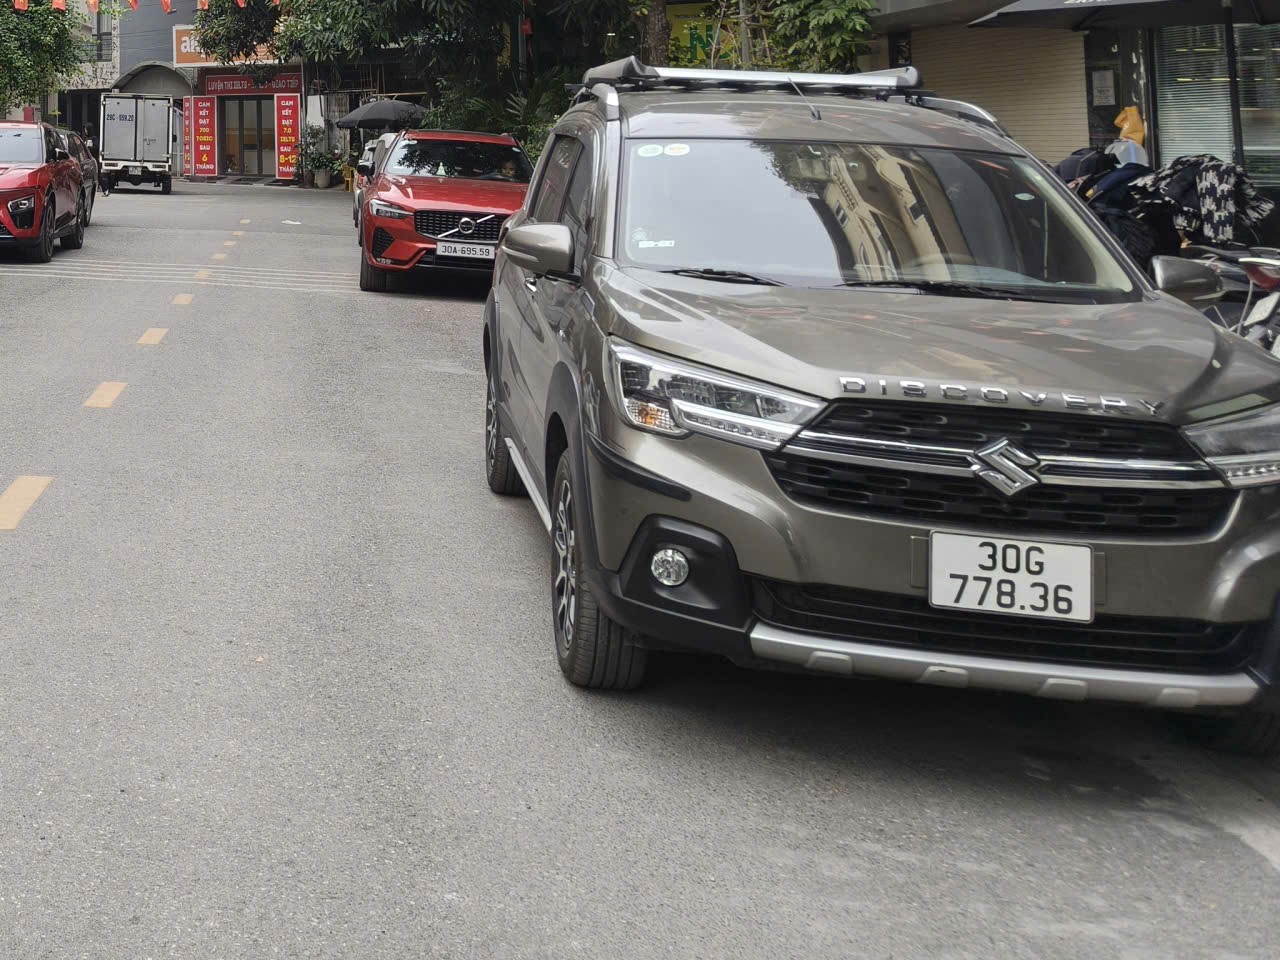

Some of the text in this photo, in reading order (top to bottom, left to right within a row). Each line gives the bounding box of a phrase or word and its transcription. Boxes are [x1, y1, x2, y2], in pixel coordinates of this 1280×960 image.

[202, 153, 208, 162] 6
[441, 245, 490, 257] 30A-695.59
[838, 375, 1166, 417] DISCOVERY
[978, 541, 1045, 576] 30G
[949, 573, 1073, 615] 778.36
